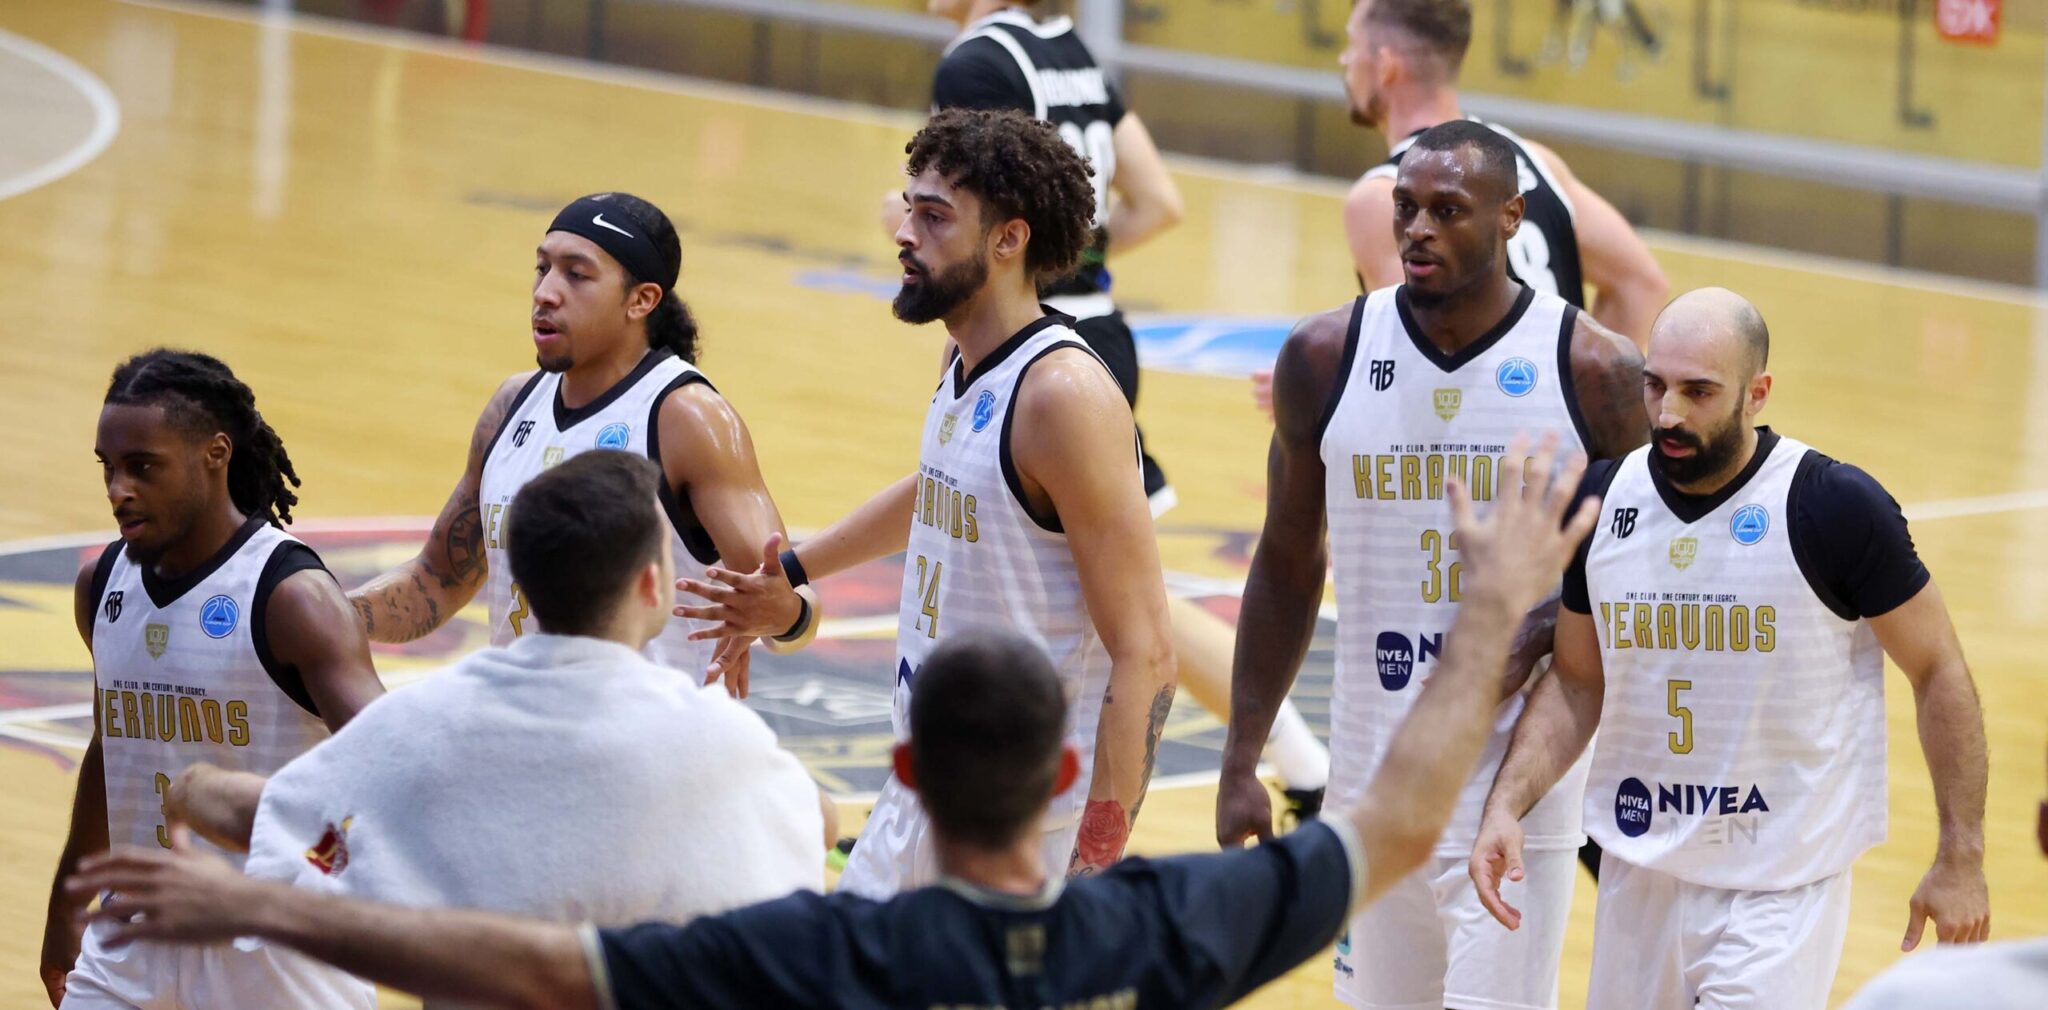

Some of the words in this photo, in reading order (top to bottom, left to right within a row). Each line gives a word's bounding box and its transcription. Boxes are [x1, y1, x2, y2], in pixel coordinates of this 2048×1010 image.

[1390, 444, 1403, 453] ONE
[1430, 444, 1441, 452] ONE
[1470, 444, 1481, 453] ONE
[1625, 592, 1638, 600] ONE
[1640, 592, 1659, 600] CLUB.
[1662, 593, 1673, 601] ONE
[1702, 594, 1714, 602] ONE
[1668, 680, 1693, 754] 5
[1618, 794, 1650, 811] NIVEA
[1658, 782, 1770, 816] NIVEA
[1620, 808, 1646, 824] MEN
